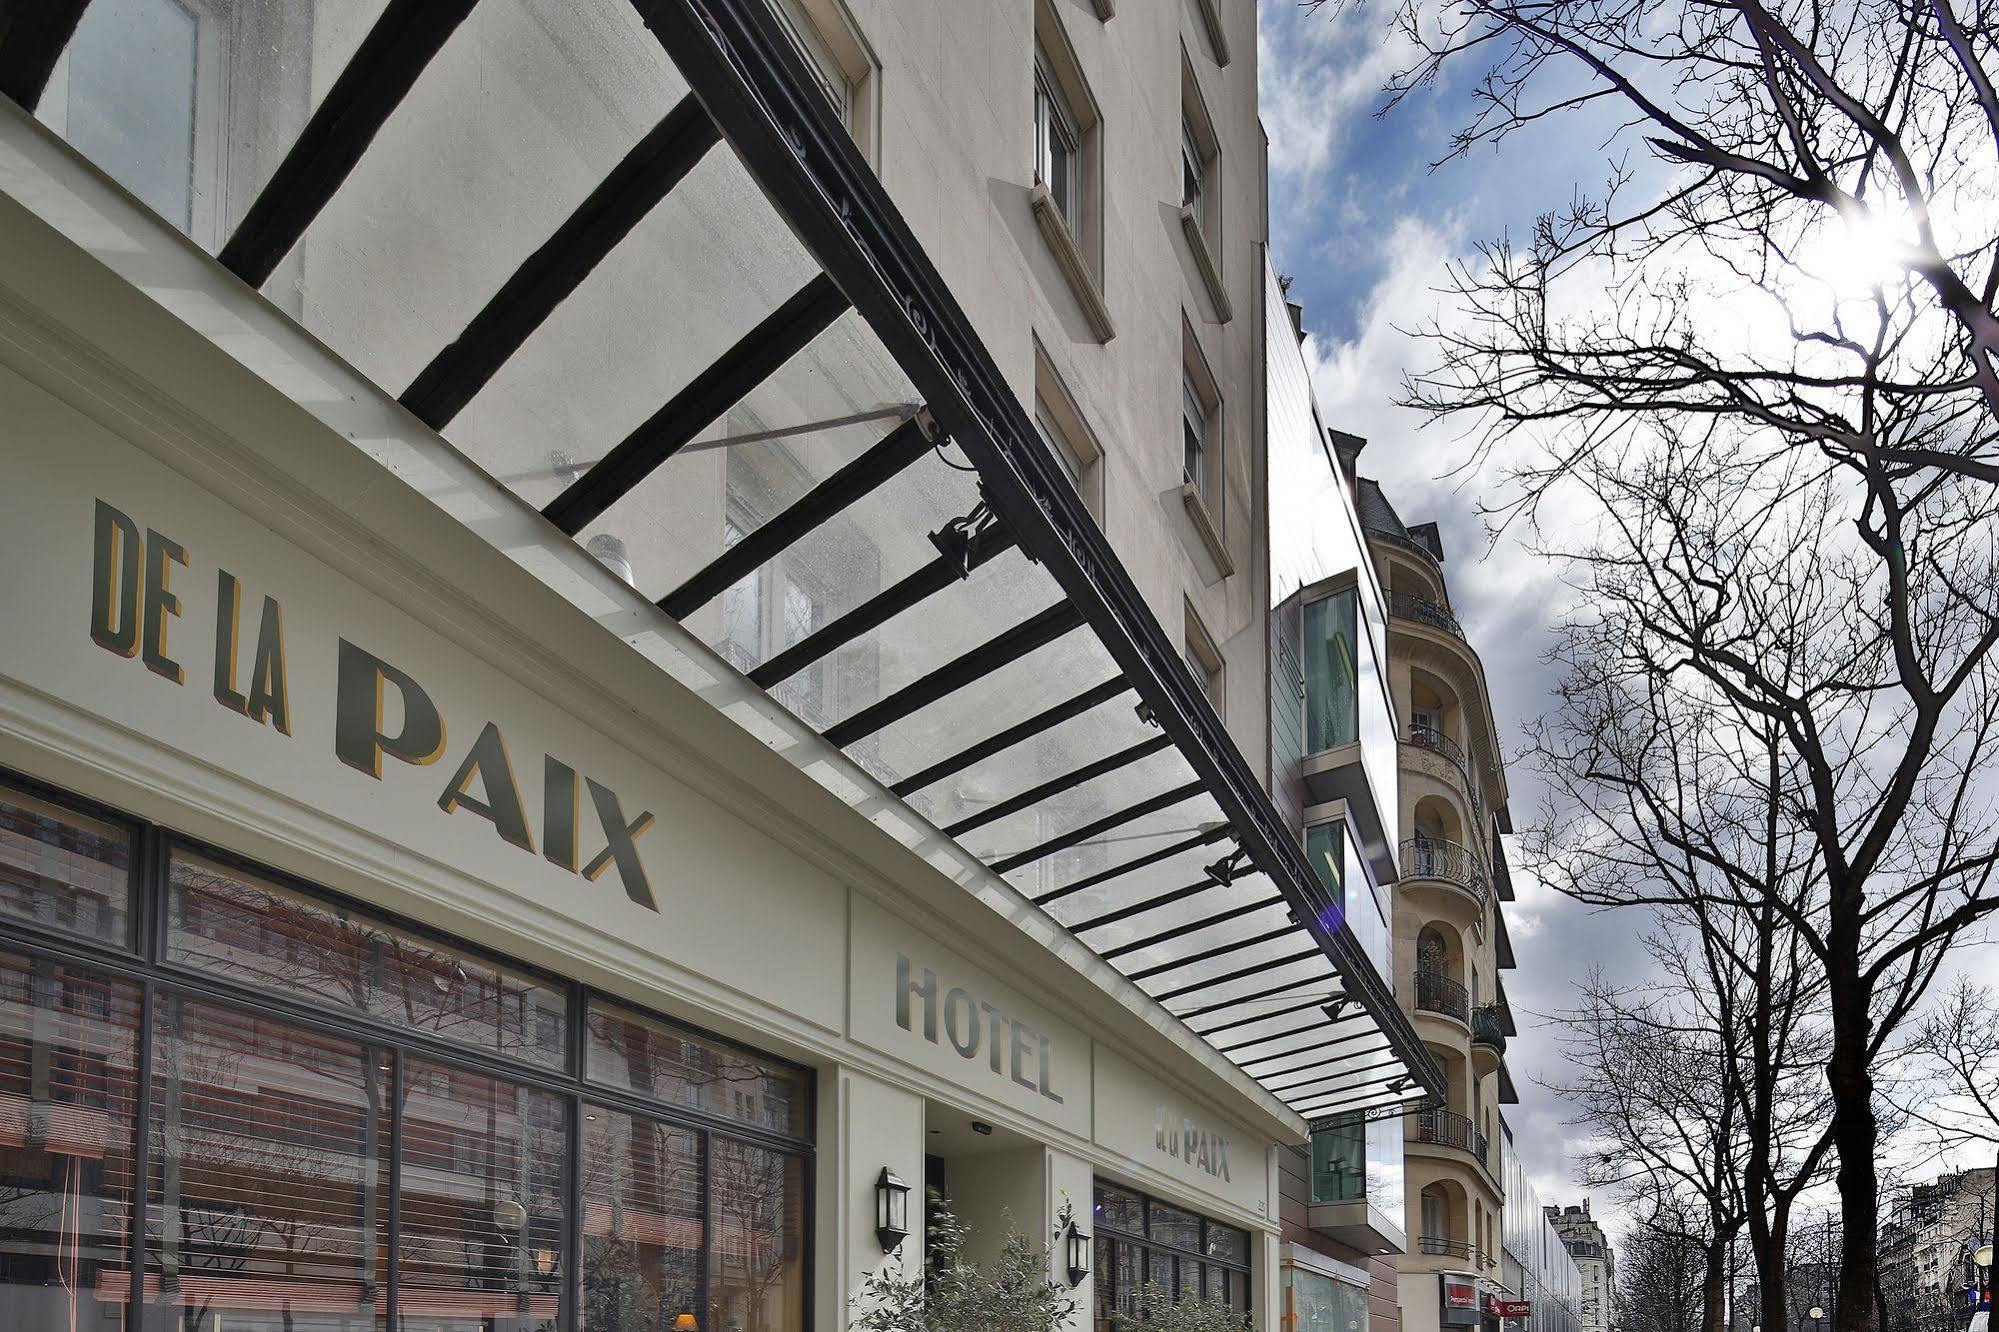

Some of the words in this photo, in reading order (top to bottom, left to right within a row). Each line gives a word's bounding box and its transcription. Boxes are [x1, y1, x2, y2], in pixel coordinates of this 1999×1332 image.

[90, 497, 190, 687] DE
[213, 567, 292, 738] LA
[335, 635, 661, 915] PAIX
[896, 951, 1064, 1105] HOTEL
[1183, 1120, 1231, 1184] PAIX
